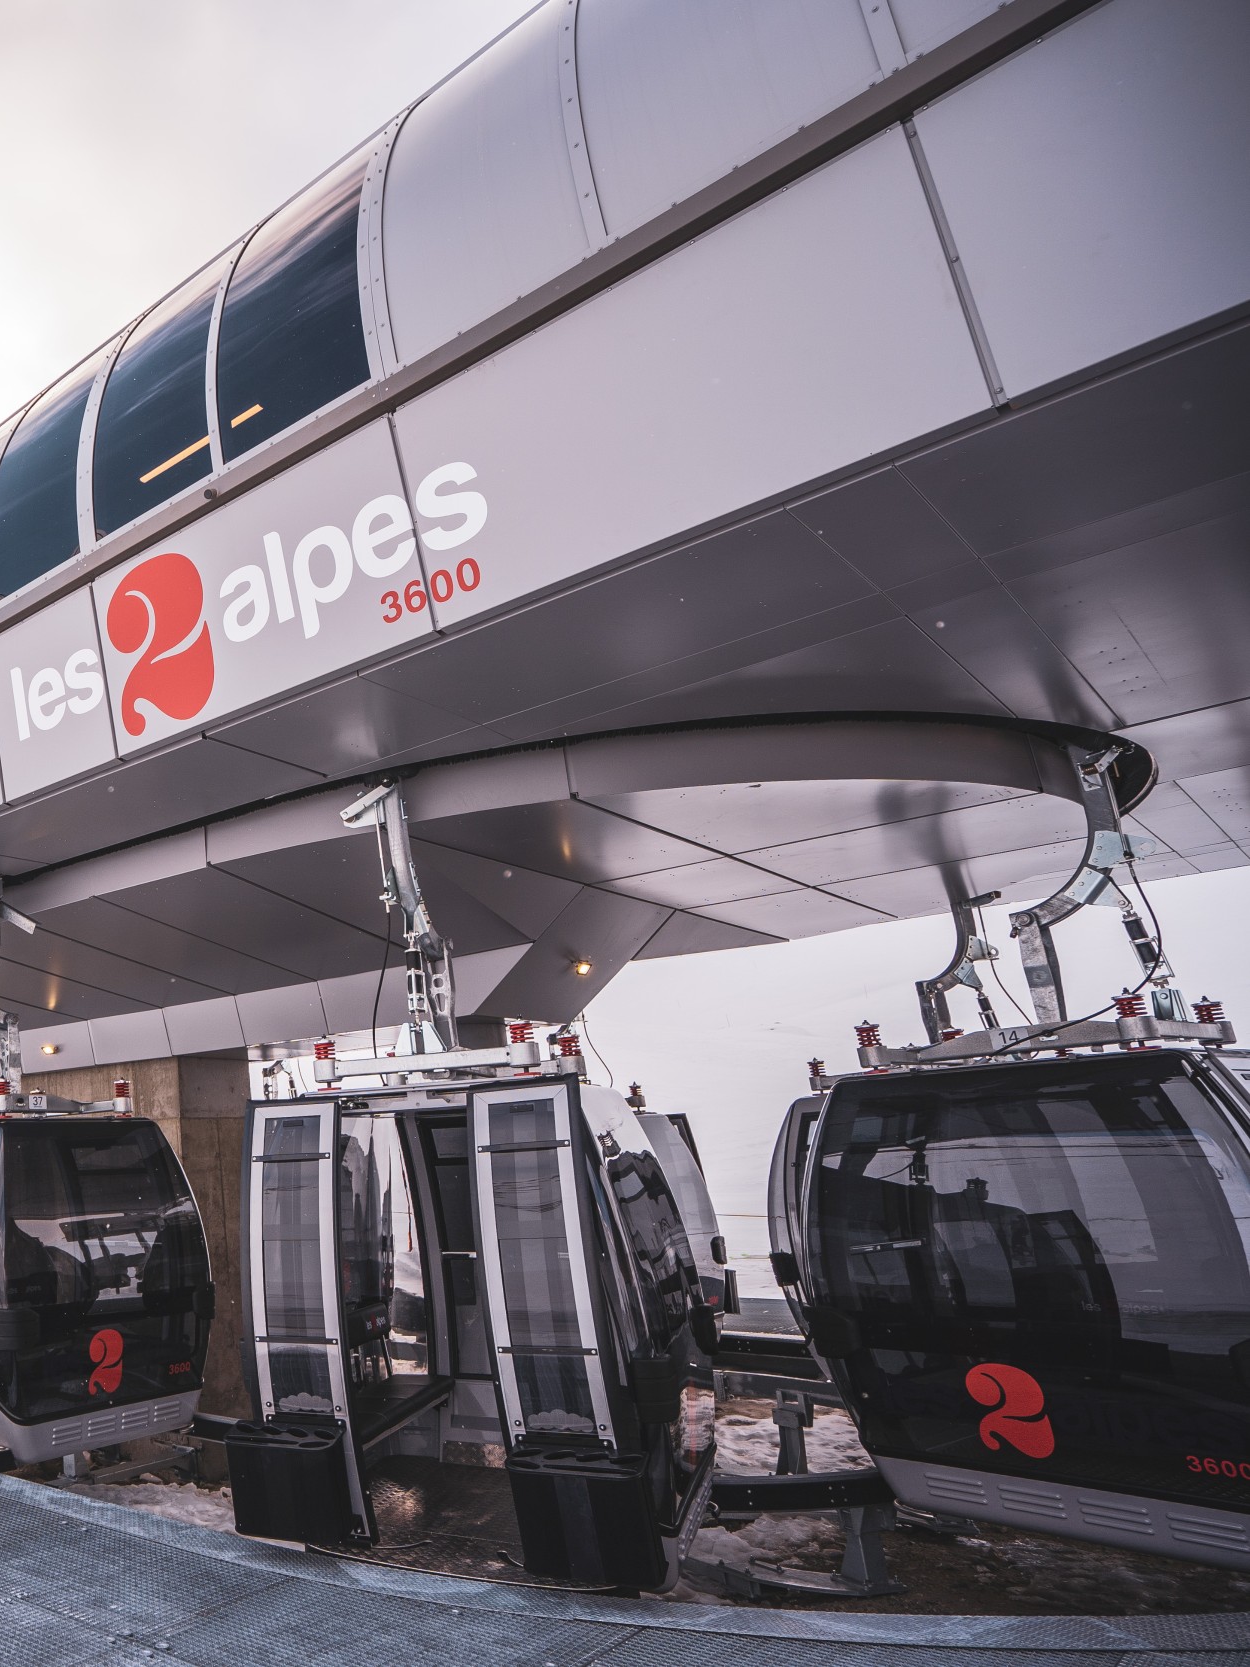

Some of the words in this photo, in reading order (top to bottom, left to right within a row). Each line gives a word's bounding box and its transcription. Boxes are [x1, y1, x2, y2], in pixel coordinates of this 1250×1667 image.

[10, 648, 104, 742] les
[107, 552, 215, 736] 2
[219, 461, 488, 643] alpes
[380, 558, 482, 624] 3600
[998, 1030, 1020, 1044] 14
[32, 1096, 43, 1106] 37
[88, 1328, 124, 1396] 2
[168, 1361, 191, 1375] 3600
[965, 1363, 1055, 1459] 2
[1185, 1455, 1250, 1481] 3600
